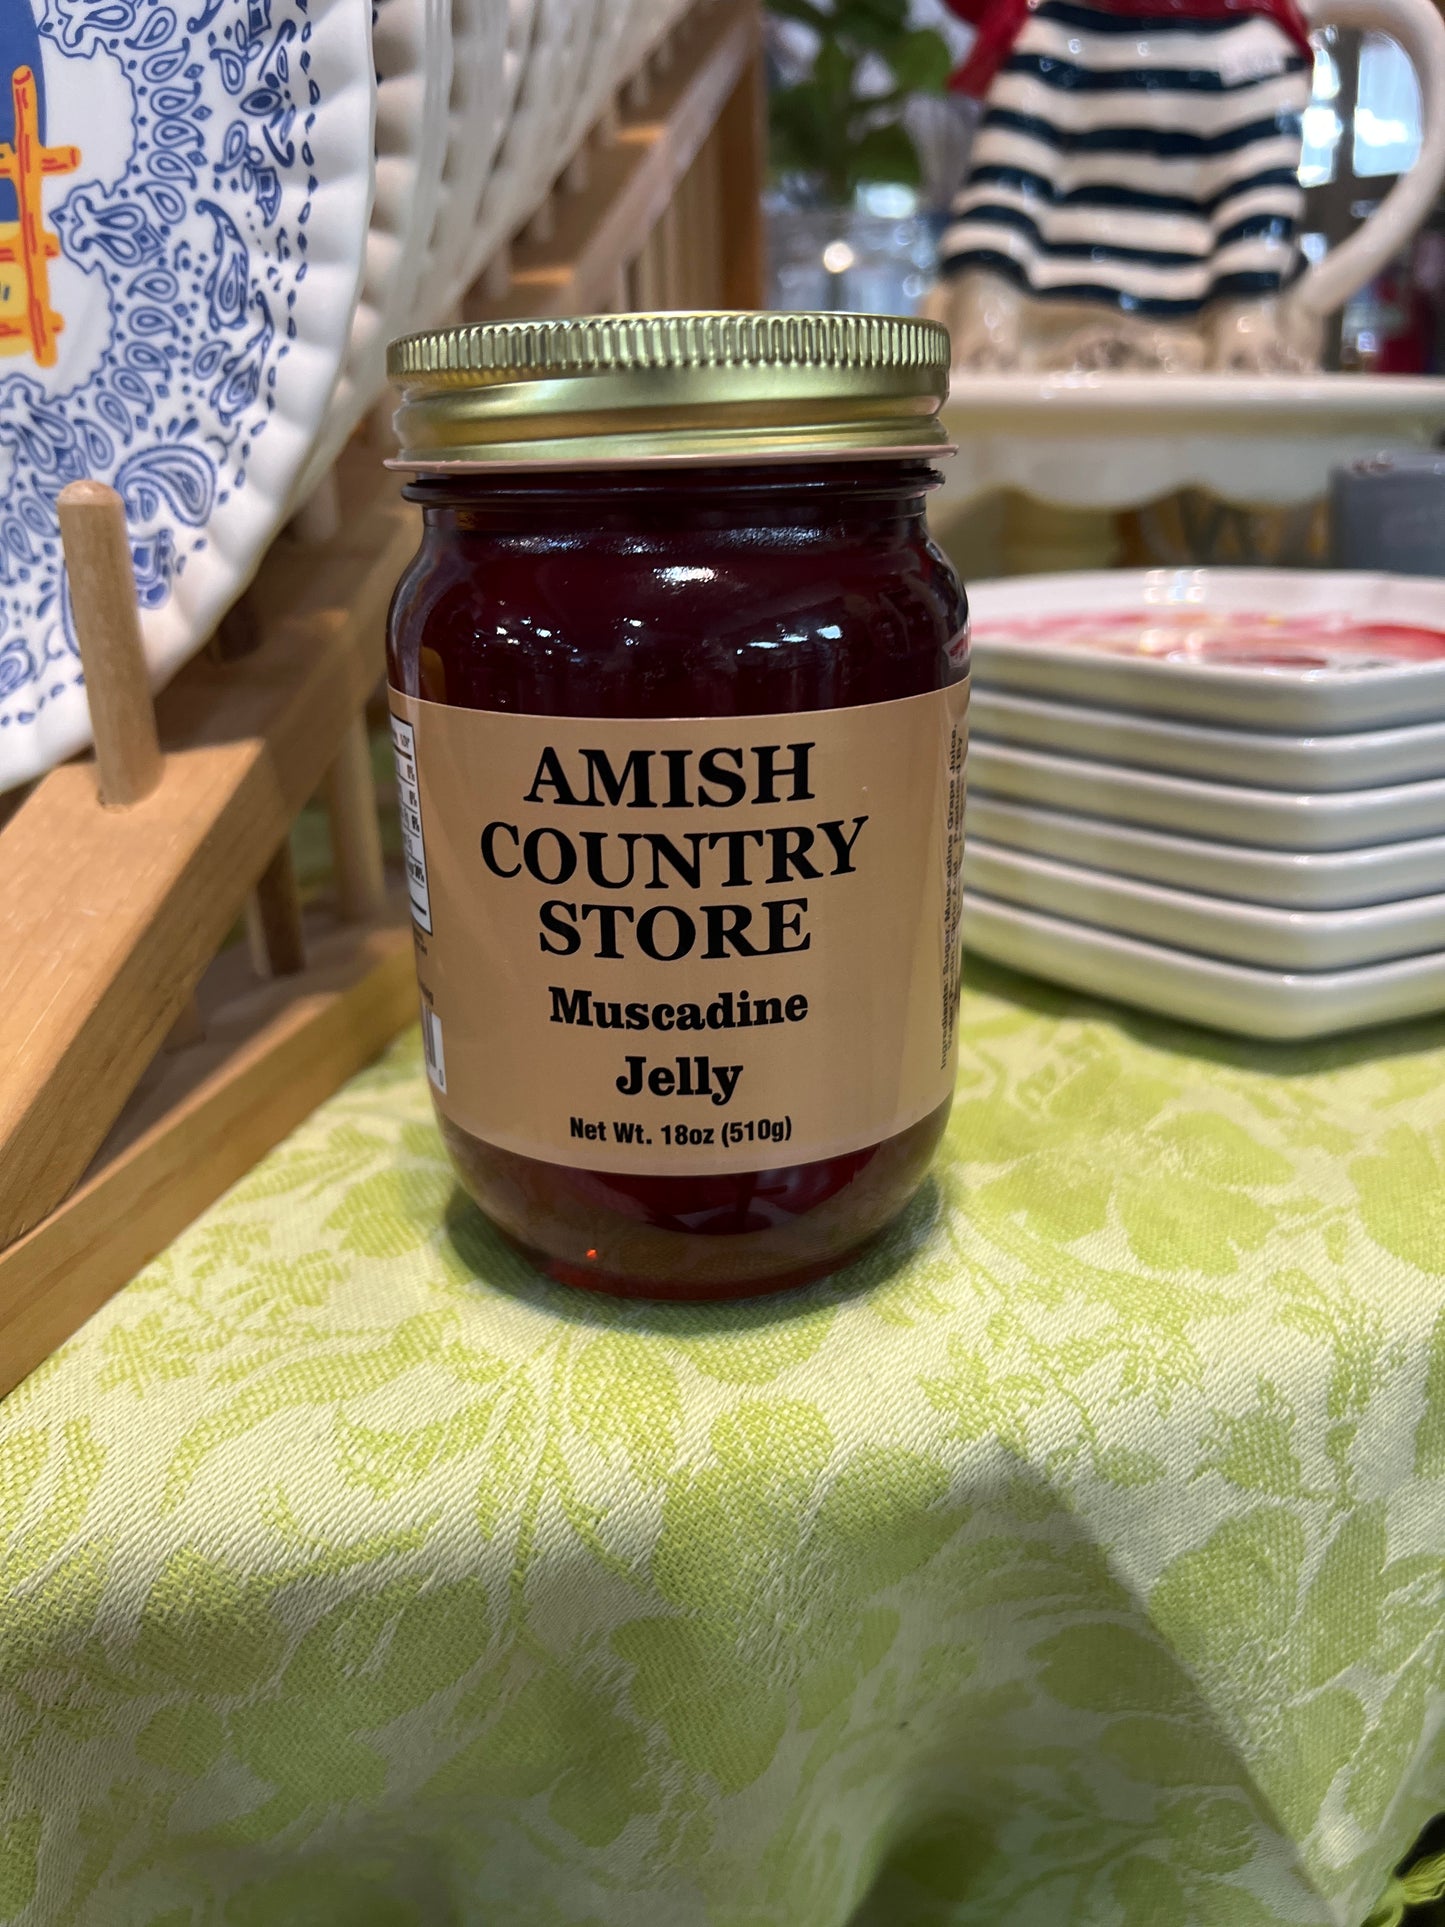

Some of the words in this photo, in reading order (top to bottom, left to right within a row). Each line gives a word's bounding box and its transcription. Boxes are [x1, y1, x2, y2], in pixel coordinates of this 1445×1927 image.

[523, 742, 816, 809] AMISH
[947, 779, 955, 830] Grape
[481, 816, 870, 890] COUNTRY
[944, 834, 953, 923] Muscadine
[540, 898, 811, 961] STORE
[548, 985, 808, 1032] Muscadine
[940, 978, 949, 1070] Ingredients:
[616, 1056, 744, 1107] Jelly
[570, 1116, 606, 1141] Net
[613, 1121, 652, 1146] Wt.
[661, 1123, 714, 1147] 18oz
[721, 1115, 792, 1149] (510g)
